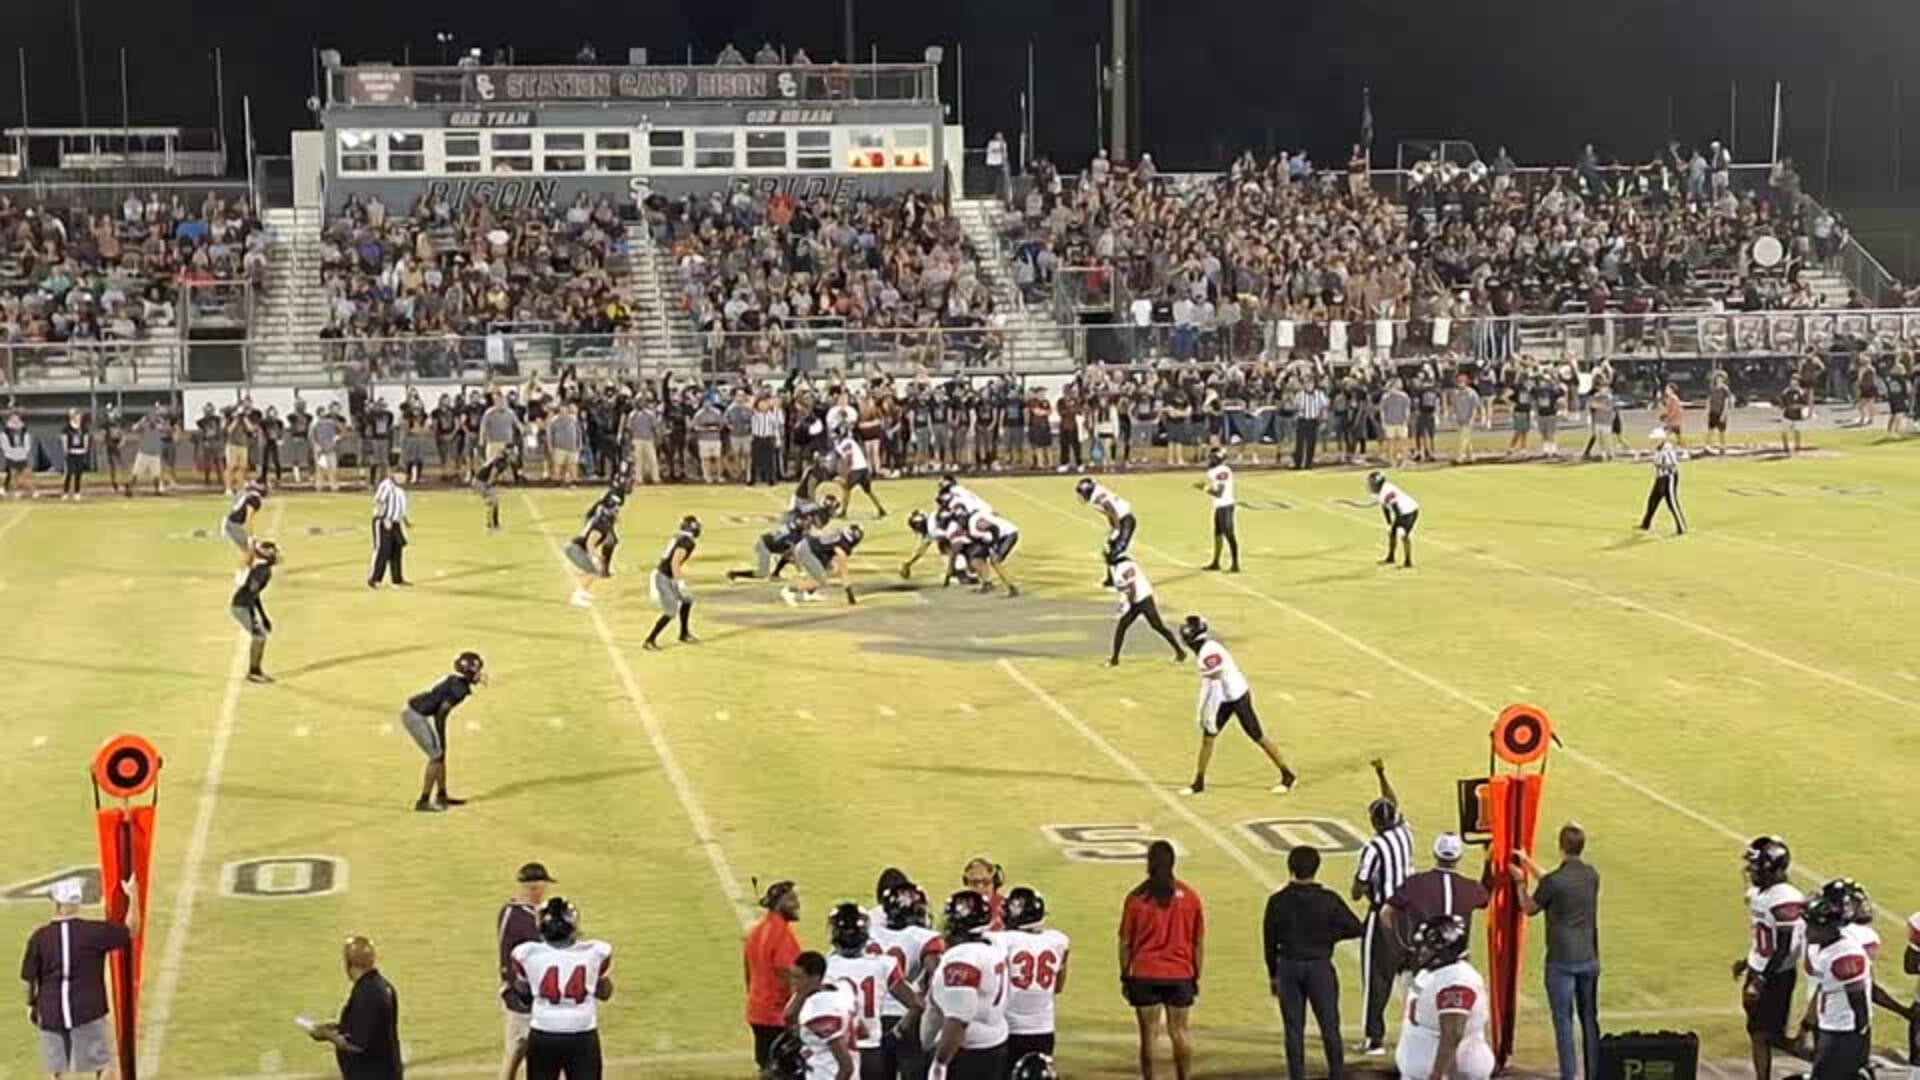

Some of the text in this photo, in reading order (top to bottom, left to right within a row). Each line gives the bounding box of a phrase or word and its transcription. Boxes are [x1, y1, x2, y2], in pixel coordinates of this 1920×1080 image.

[506, 72, 611, 97] STATION
[619, 72, 688, 97] CAMP
[697, 72, 768, 97] BISON
[487, 111, 529, 126] TEAM
[538, 964, 589, 1005] 44
[1009, 949, 1057, 990] 36
